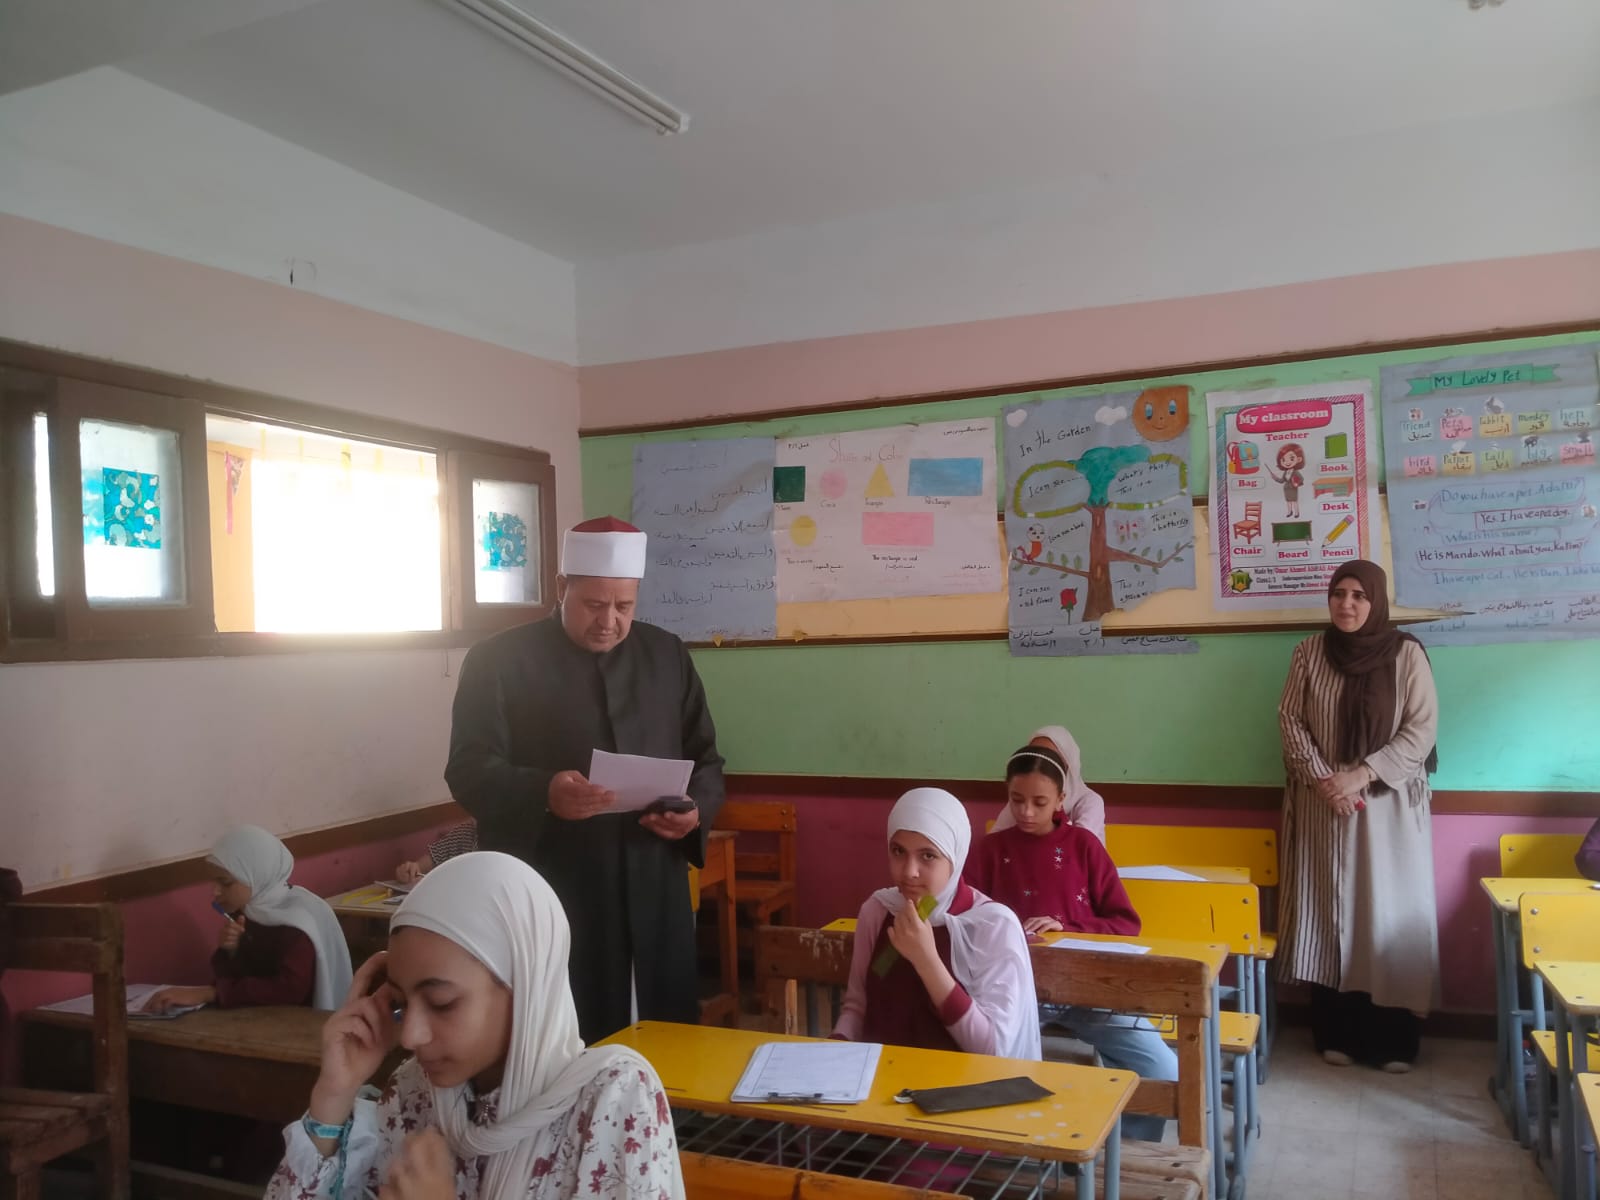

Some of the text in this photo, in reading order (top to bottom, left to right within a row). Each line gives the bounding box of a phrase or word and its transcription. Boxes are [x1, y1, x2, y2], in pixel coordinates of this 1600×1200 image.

[1462, 370, 1497, 386] Lovely
[1503, 370, 1521, 384] Pet
[1239, 410, 1328, 425] My classroom
[1265, 432, 1310, 442] Teacher
[1019, 443, 1033, 458] In
[1320, 464, 1348, 472] Book
[1238, 480, 1258, 488] Bag
[1442, 490, 1459, 502] Do
[1460, 493, 1478, 502] you
[1480, 488, 1506, 500] have
[1322, 502, 1350, 511] Desk
[1510, 510, 1534, 520] have
[1234, 547, 1262, 555] Chair
[1278, 550, 1308, 558] Board
[1322, 549, 1354, 558] Pencil
[1419, 551, 1432, 562] He
[1434, 550, 1444, 560] is
[1481, 547, 1505, 558] What
